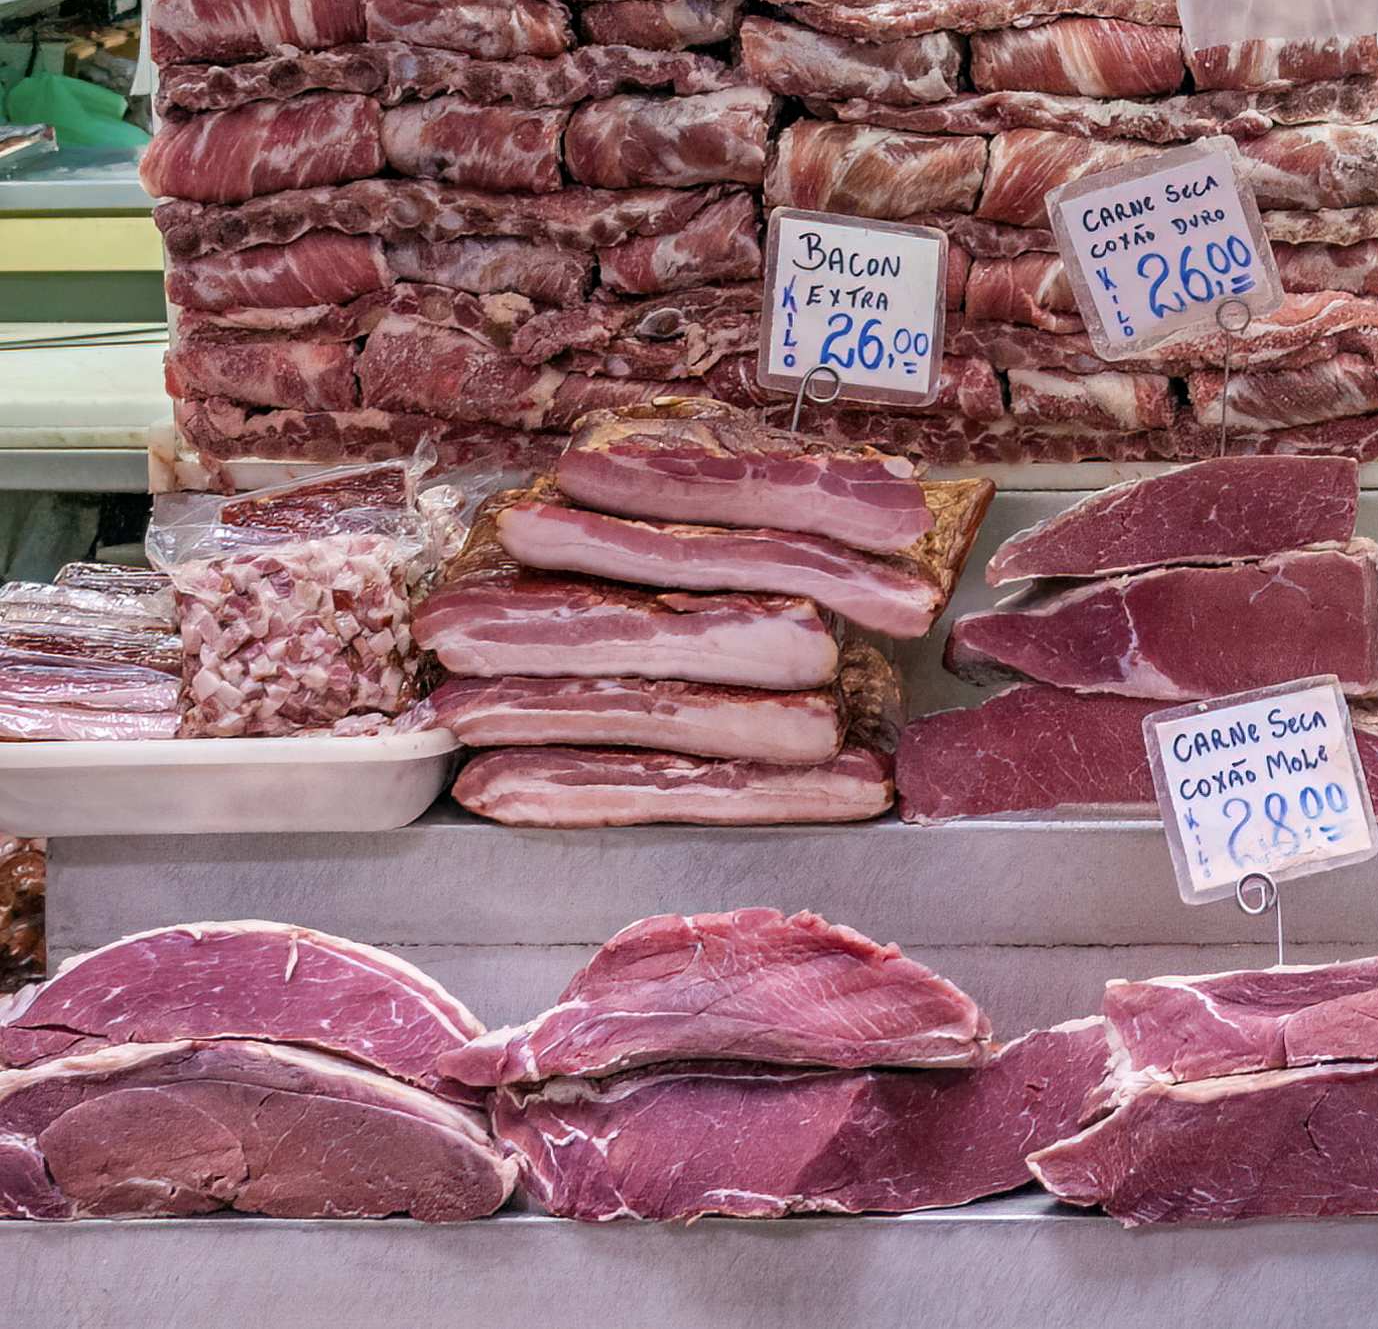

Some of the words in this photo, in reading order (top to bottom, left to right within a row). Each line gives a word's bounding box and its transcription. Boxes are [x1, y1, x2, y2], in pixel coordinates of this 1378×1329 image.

[793, 232, 901, 271] BACON
[1171, 209, 1225, 235] DURO
[806, 285, 889, 311] EXTRA
[1096, 267, 1134, 337] KILO
[1137, 235, 1251, 319] 26,00
[782, 275, 797, 367] KILO
[820, 313, 929, 370] 26,00
[1184, 808, 1211, 878] KILO
